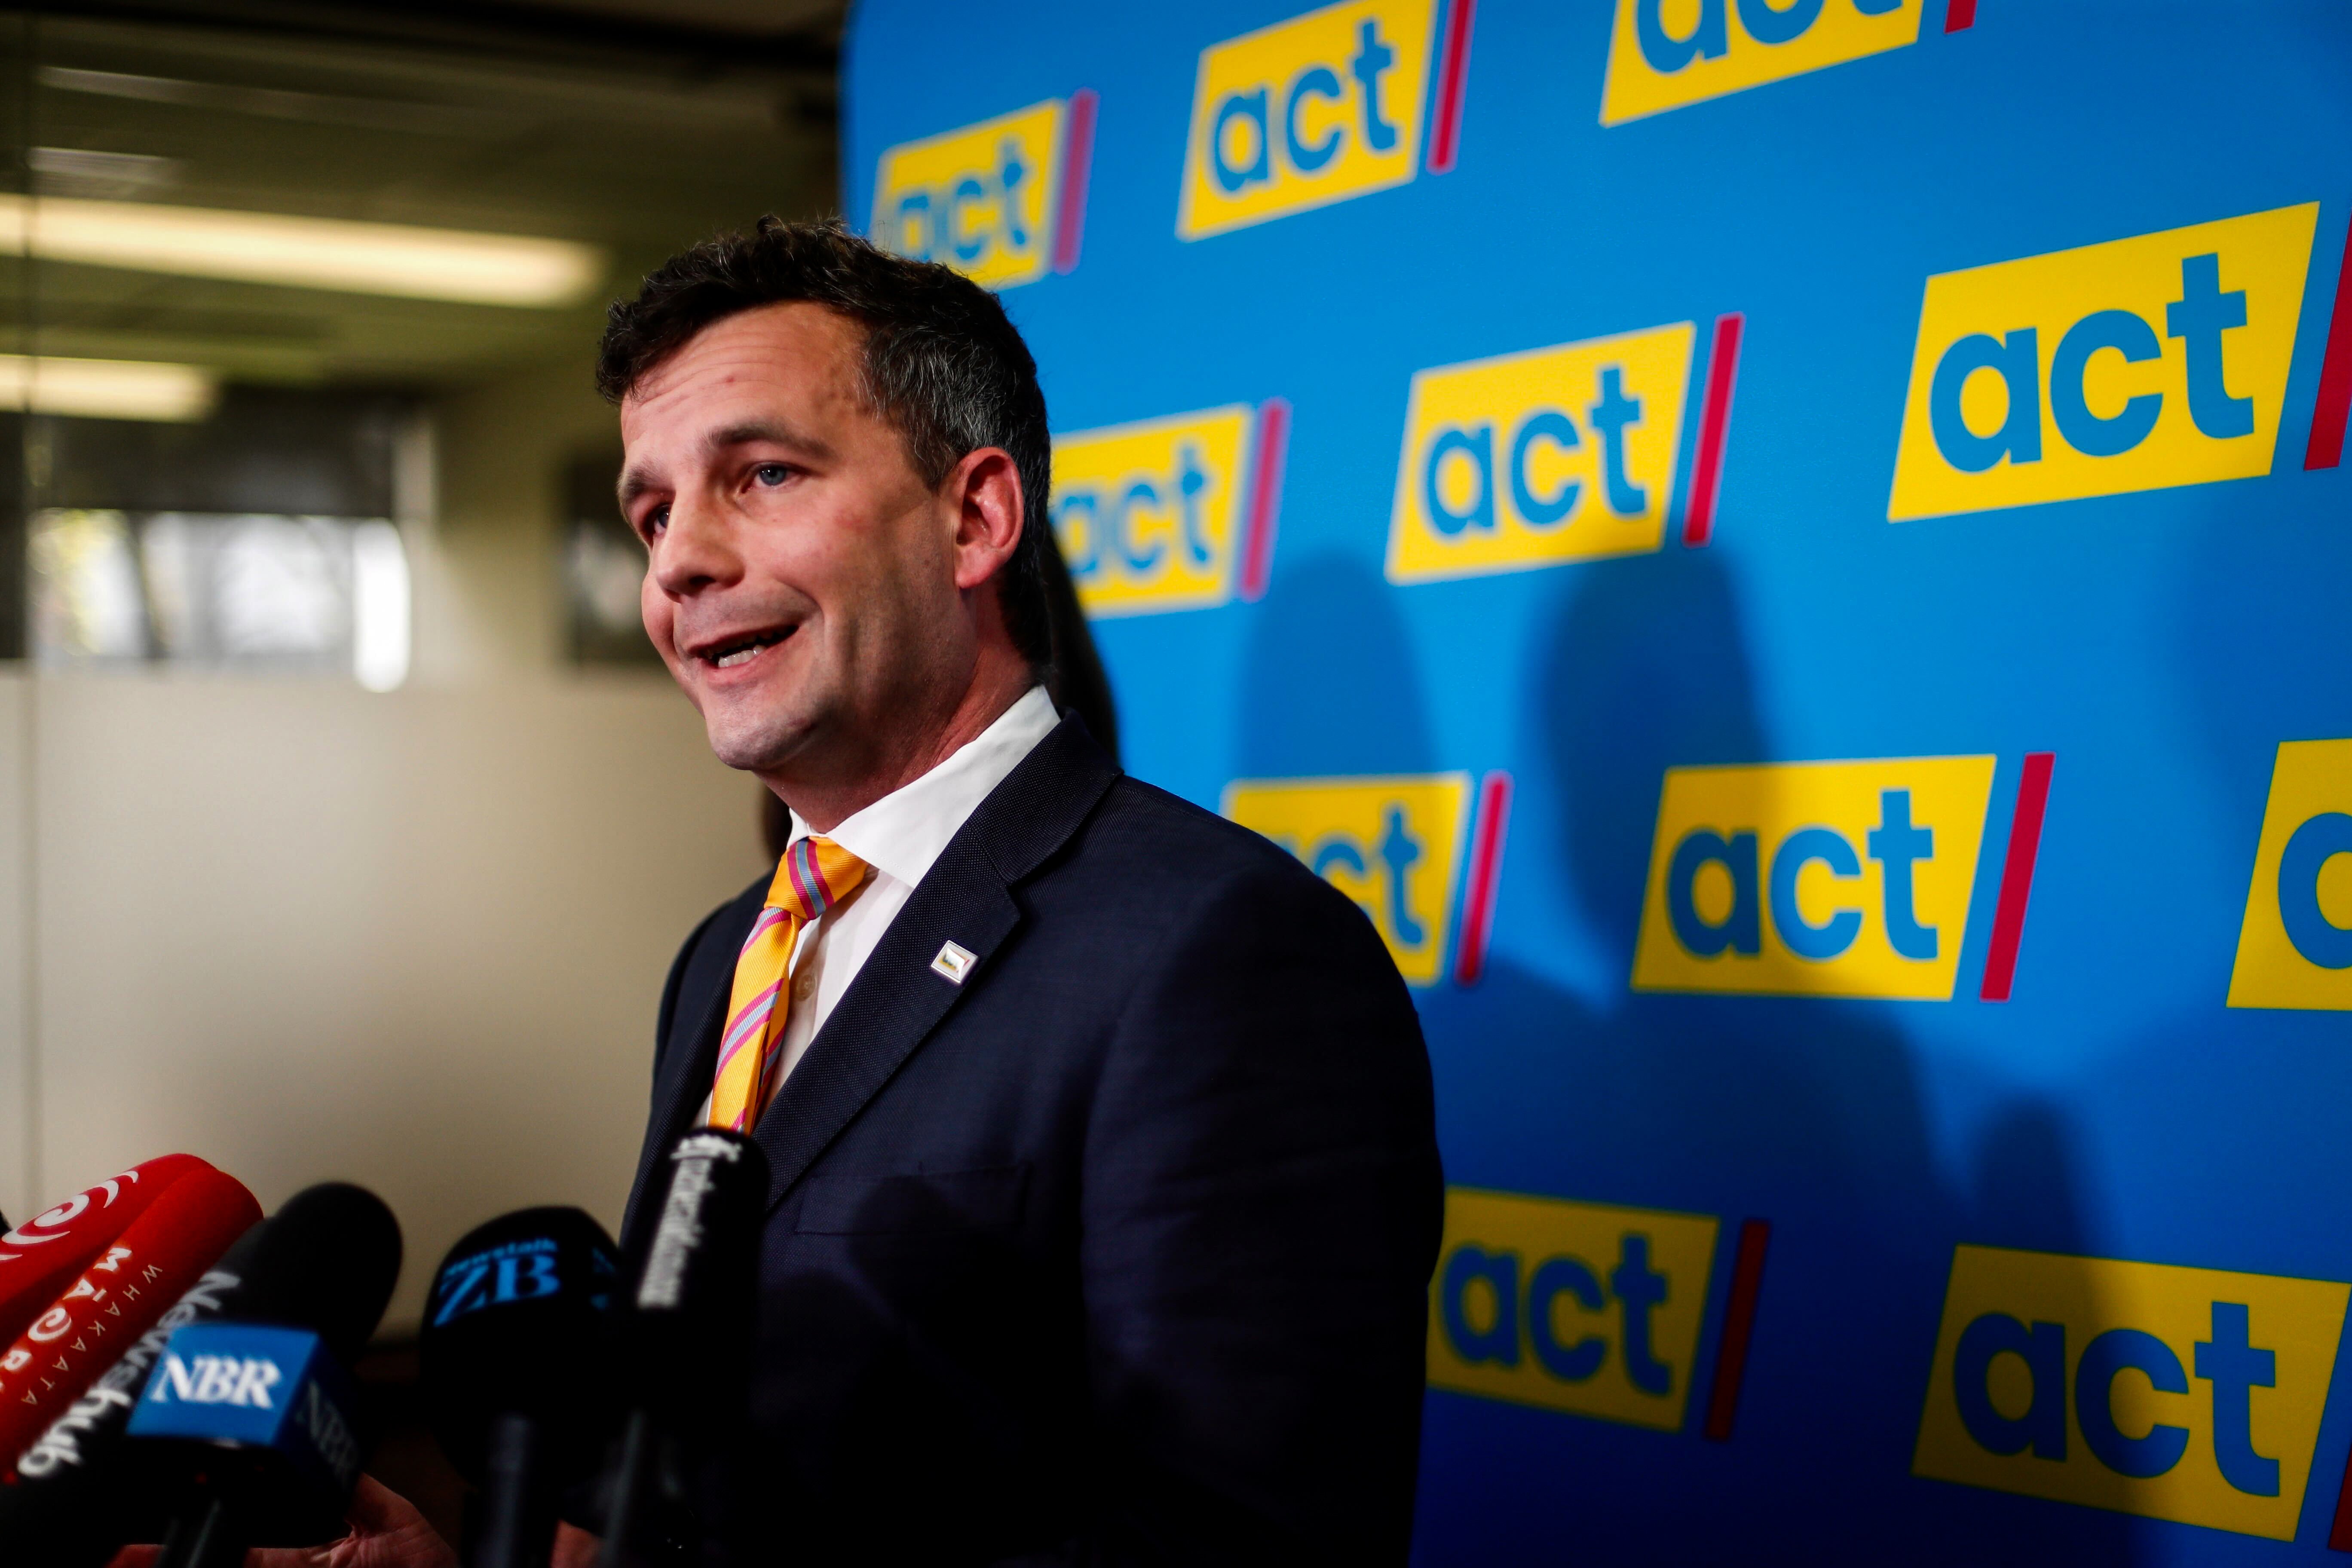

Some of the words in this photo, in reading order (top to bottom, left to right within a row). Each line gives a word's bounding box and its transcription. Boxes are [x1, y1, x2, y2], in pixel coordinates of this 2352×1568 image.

[1211, 18, 1398, 192] act
[896, 138, 1036, 262] act
[1929, 252, 2255, 473] act
[1053, 443, 1214, 574] act
[1425, 368, 1647, 534] act
[1668, 788, 1939, 960] act
[0, 1247, 132, 1393] MĀOR
[21, 1264, 162, 1405] WHAKAATA
[433, 1254, 560, 1327] ZB
[1441, 1233, 1671, 1397] act
[150, 1355, 282, 1410] NBR
[1954, 1301, 2279, 1497] act
